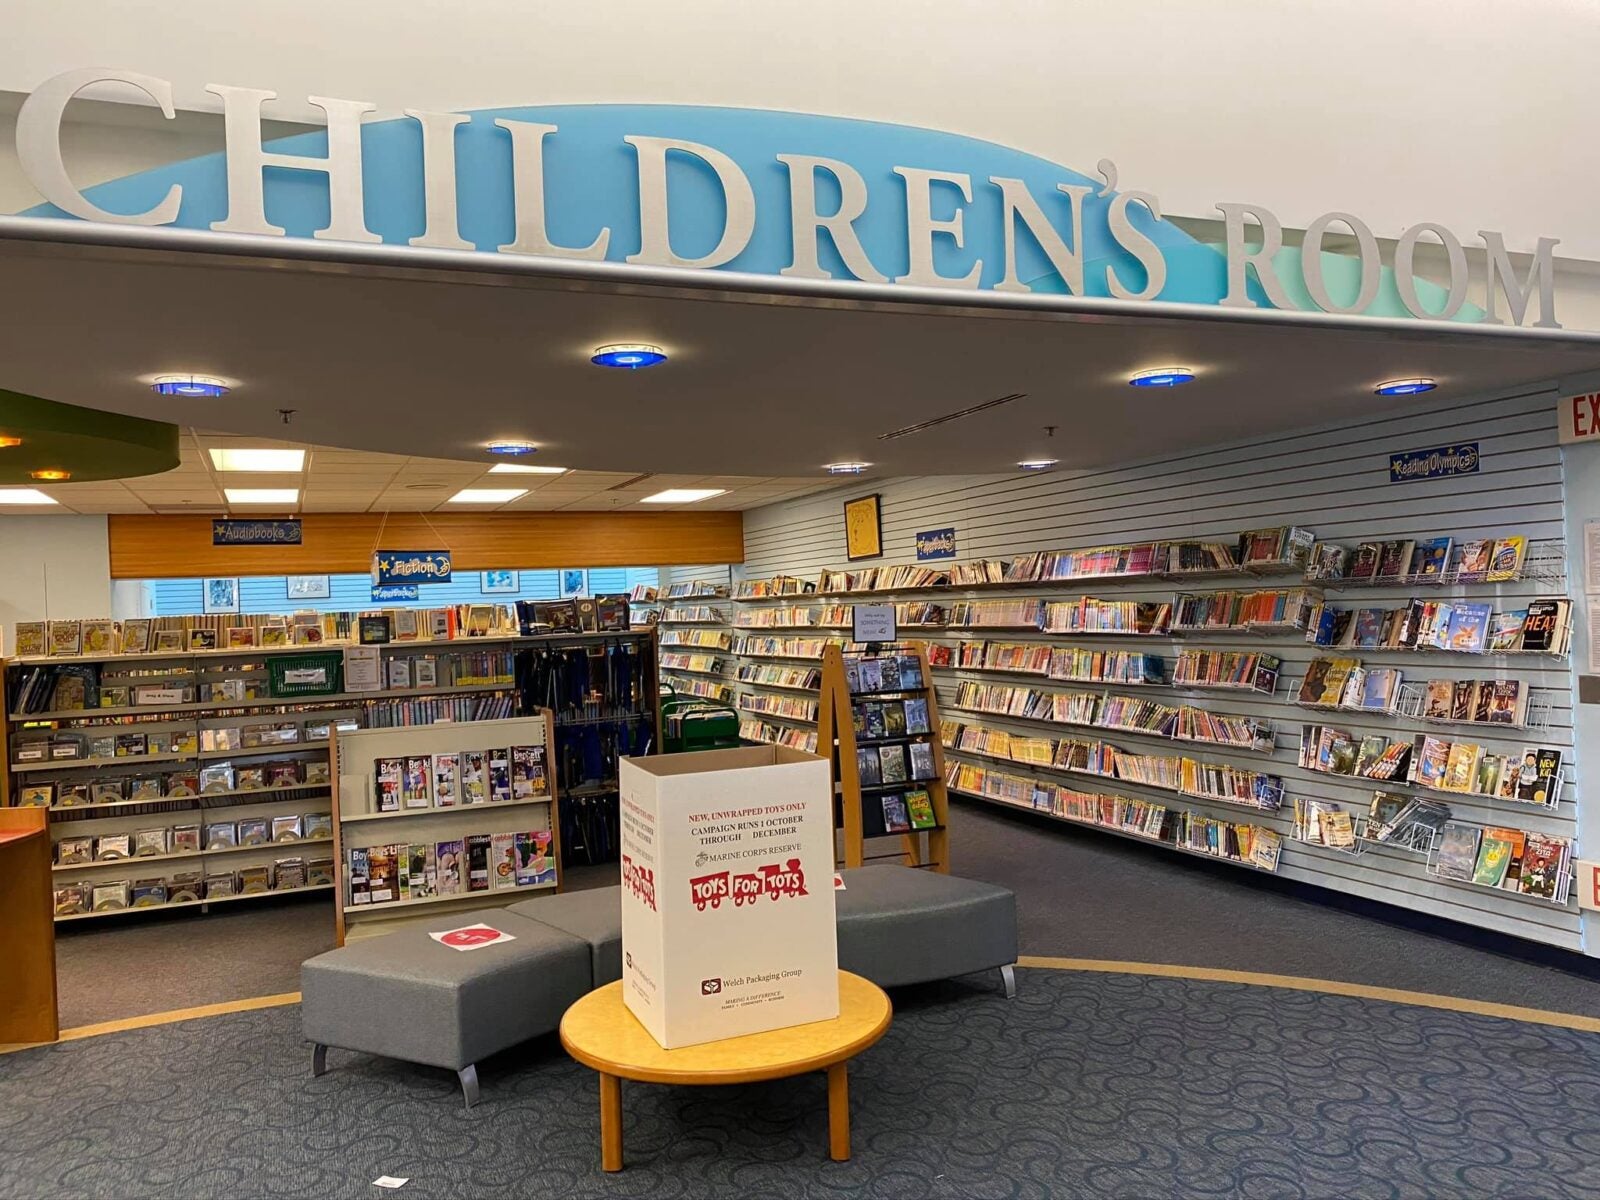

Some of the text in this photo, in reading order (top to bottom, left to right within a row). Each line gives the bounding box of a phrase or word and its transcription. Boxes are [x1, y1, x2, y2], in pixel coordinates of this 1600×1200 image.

[16, 67, 1563, 330] CHILDREN'S ROOM
[1395, 452, 1470, 476] Reading Olympics
[225, 526, 285, 540] Audiobooks
[396, 560, 434, 574] Fiction
[1540, 759, 1556, 769] NEW
[688, 802, 807, 823] NEW, UNWRAPPED TOYS ONLY
[691, 824, 737, 836] CAMPAIGN
[737, 820, 759, 831] RUNS
[765, 815, 804, 826] OCTOBER
[700, 826, 797, 845] THROUGH DECEMBER
[709, 843, 802, 863] MARINE CORPS RESERVE
[694, 872, 800, 899] TOYS FOR TOTS
[723, 969, 803, 988] Welch Packaging Group
